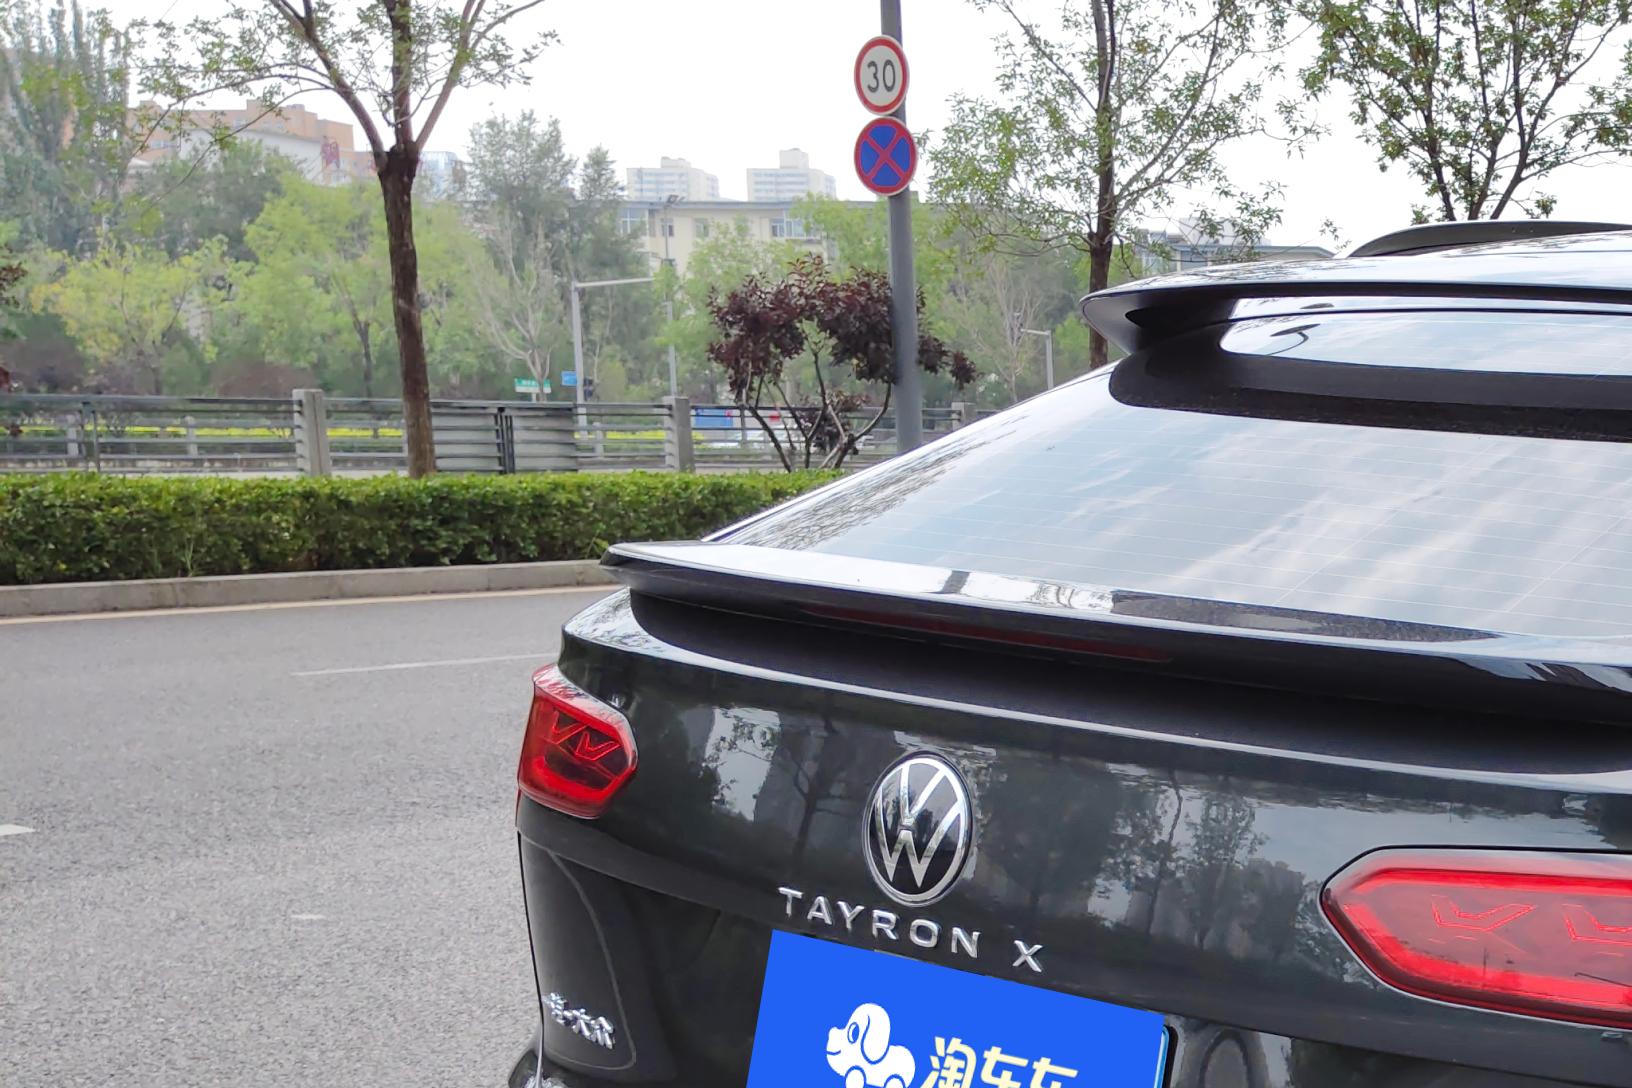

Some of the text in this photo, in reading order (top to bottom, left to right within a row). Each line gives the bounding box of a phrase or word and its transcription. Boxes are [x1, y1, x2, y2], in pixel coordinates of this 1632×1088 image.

[867, 59, 896, 93] 30
[778, 886, 1043, 973] TAYRON X
